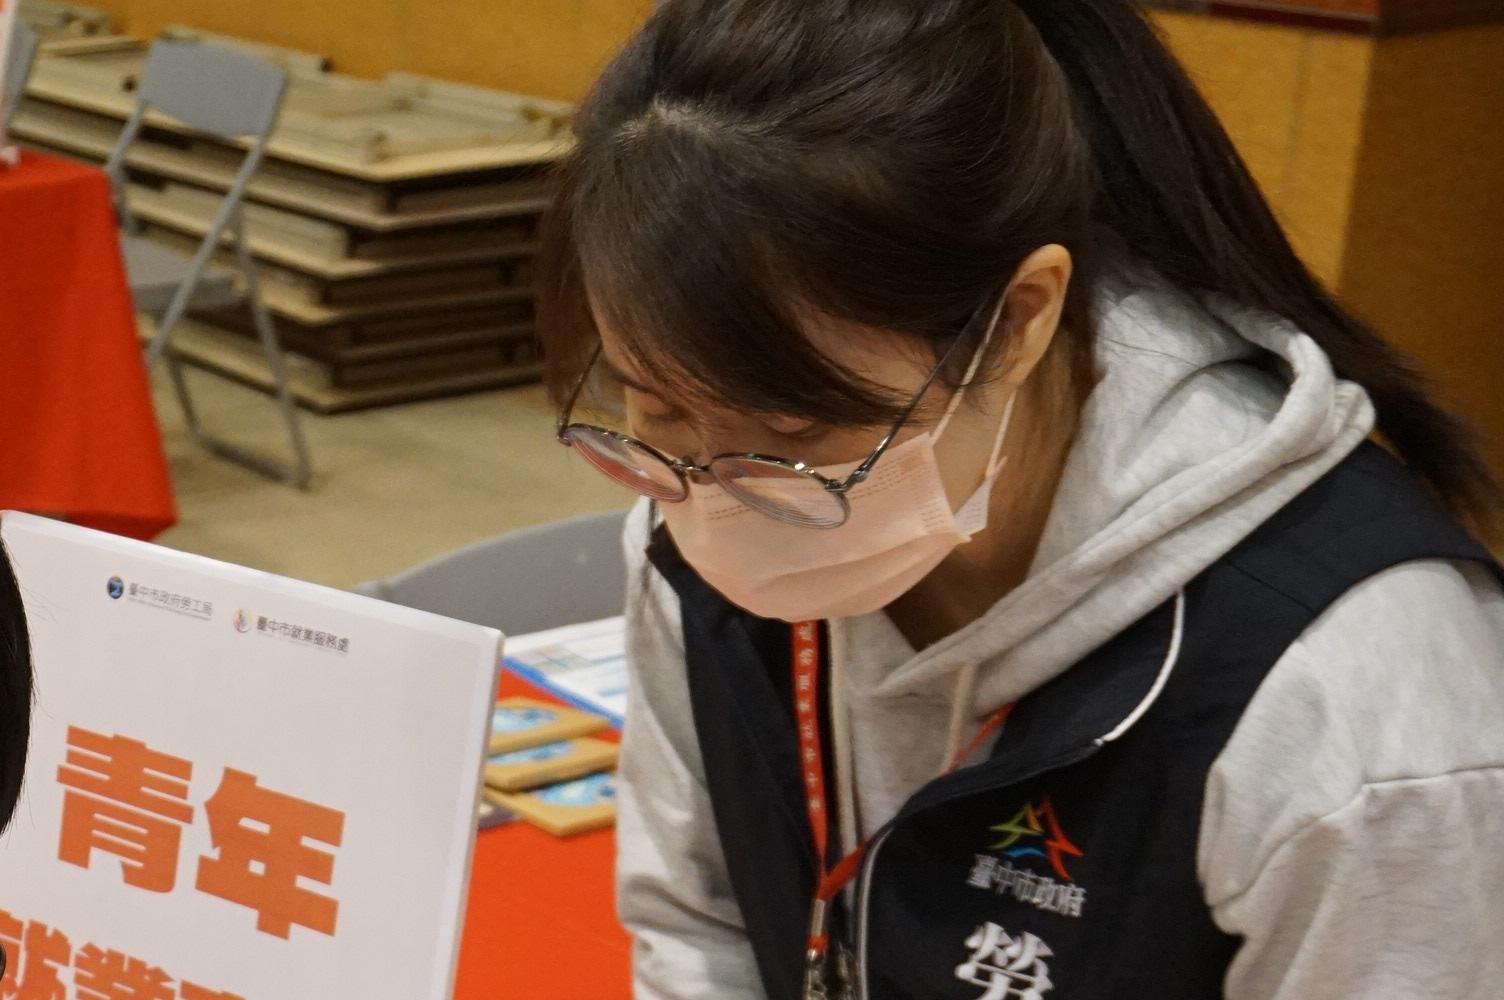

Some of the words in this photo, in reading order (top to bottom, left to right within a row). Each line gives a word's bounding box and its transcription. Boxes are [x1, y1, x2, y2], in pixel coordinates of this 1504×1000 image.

[57, 725, 346, 941] 青年
[965, 853, 1088, 918] 臺中市政府
